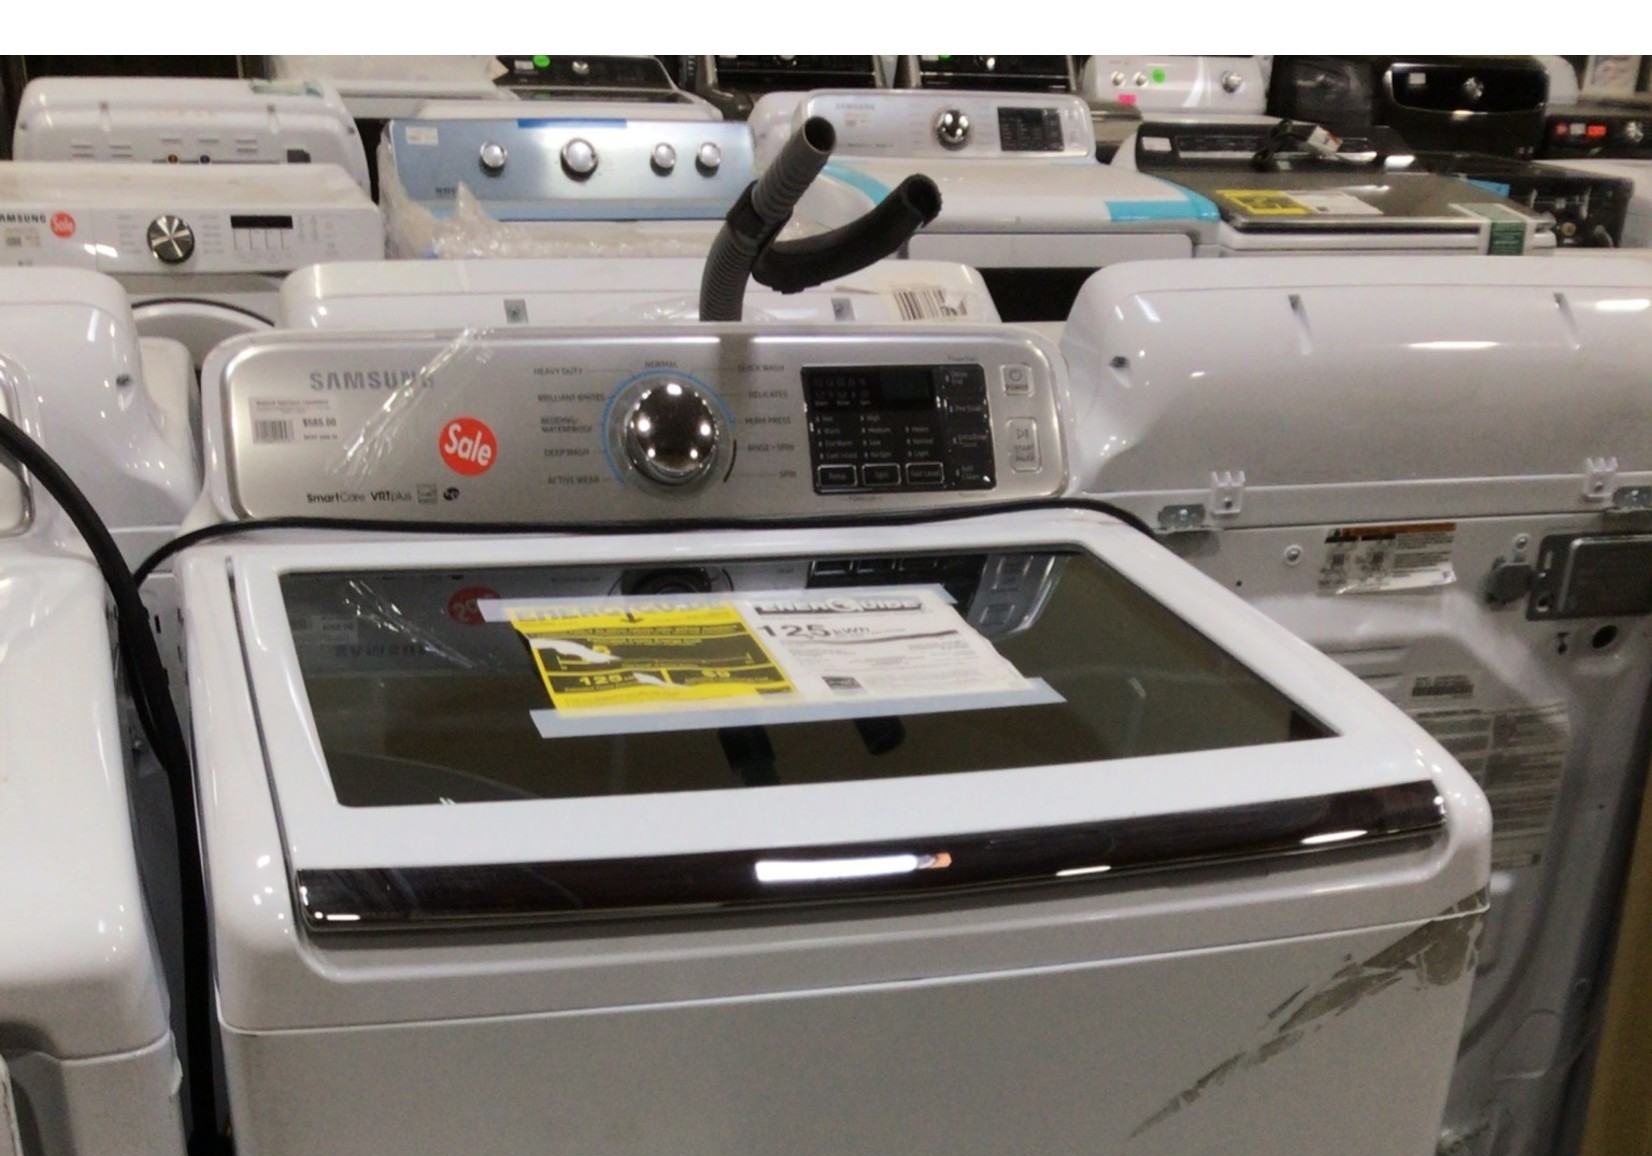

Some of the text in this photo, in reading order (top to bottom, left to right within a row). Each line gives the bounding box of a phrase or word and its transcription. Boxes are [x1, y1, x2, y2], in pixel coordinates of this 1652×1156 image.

[0, 213, 46, 222] AMSUNG
[444, 422, 493, 467] Sale
[306, 491, 366, 504] SmartCare
[757, 624, 831, 639] 125
